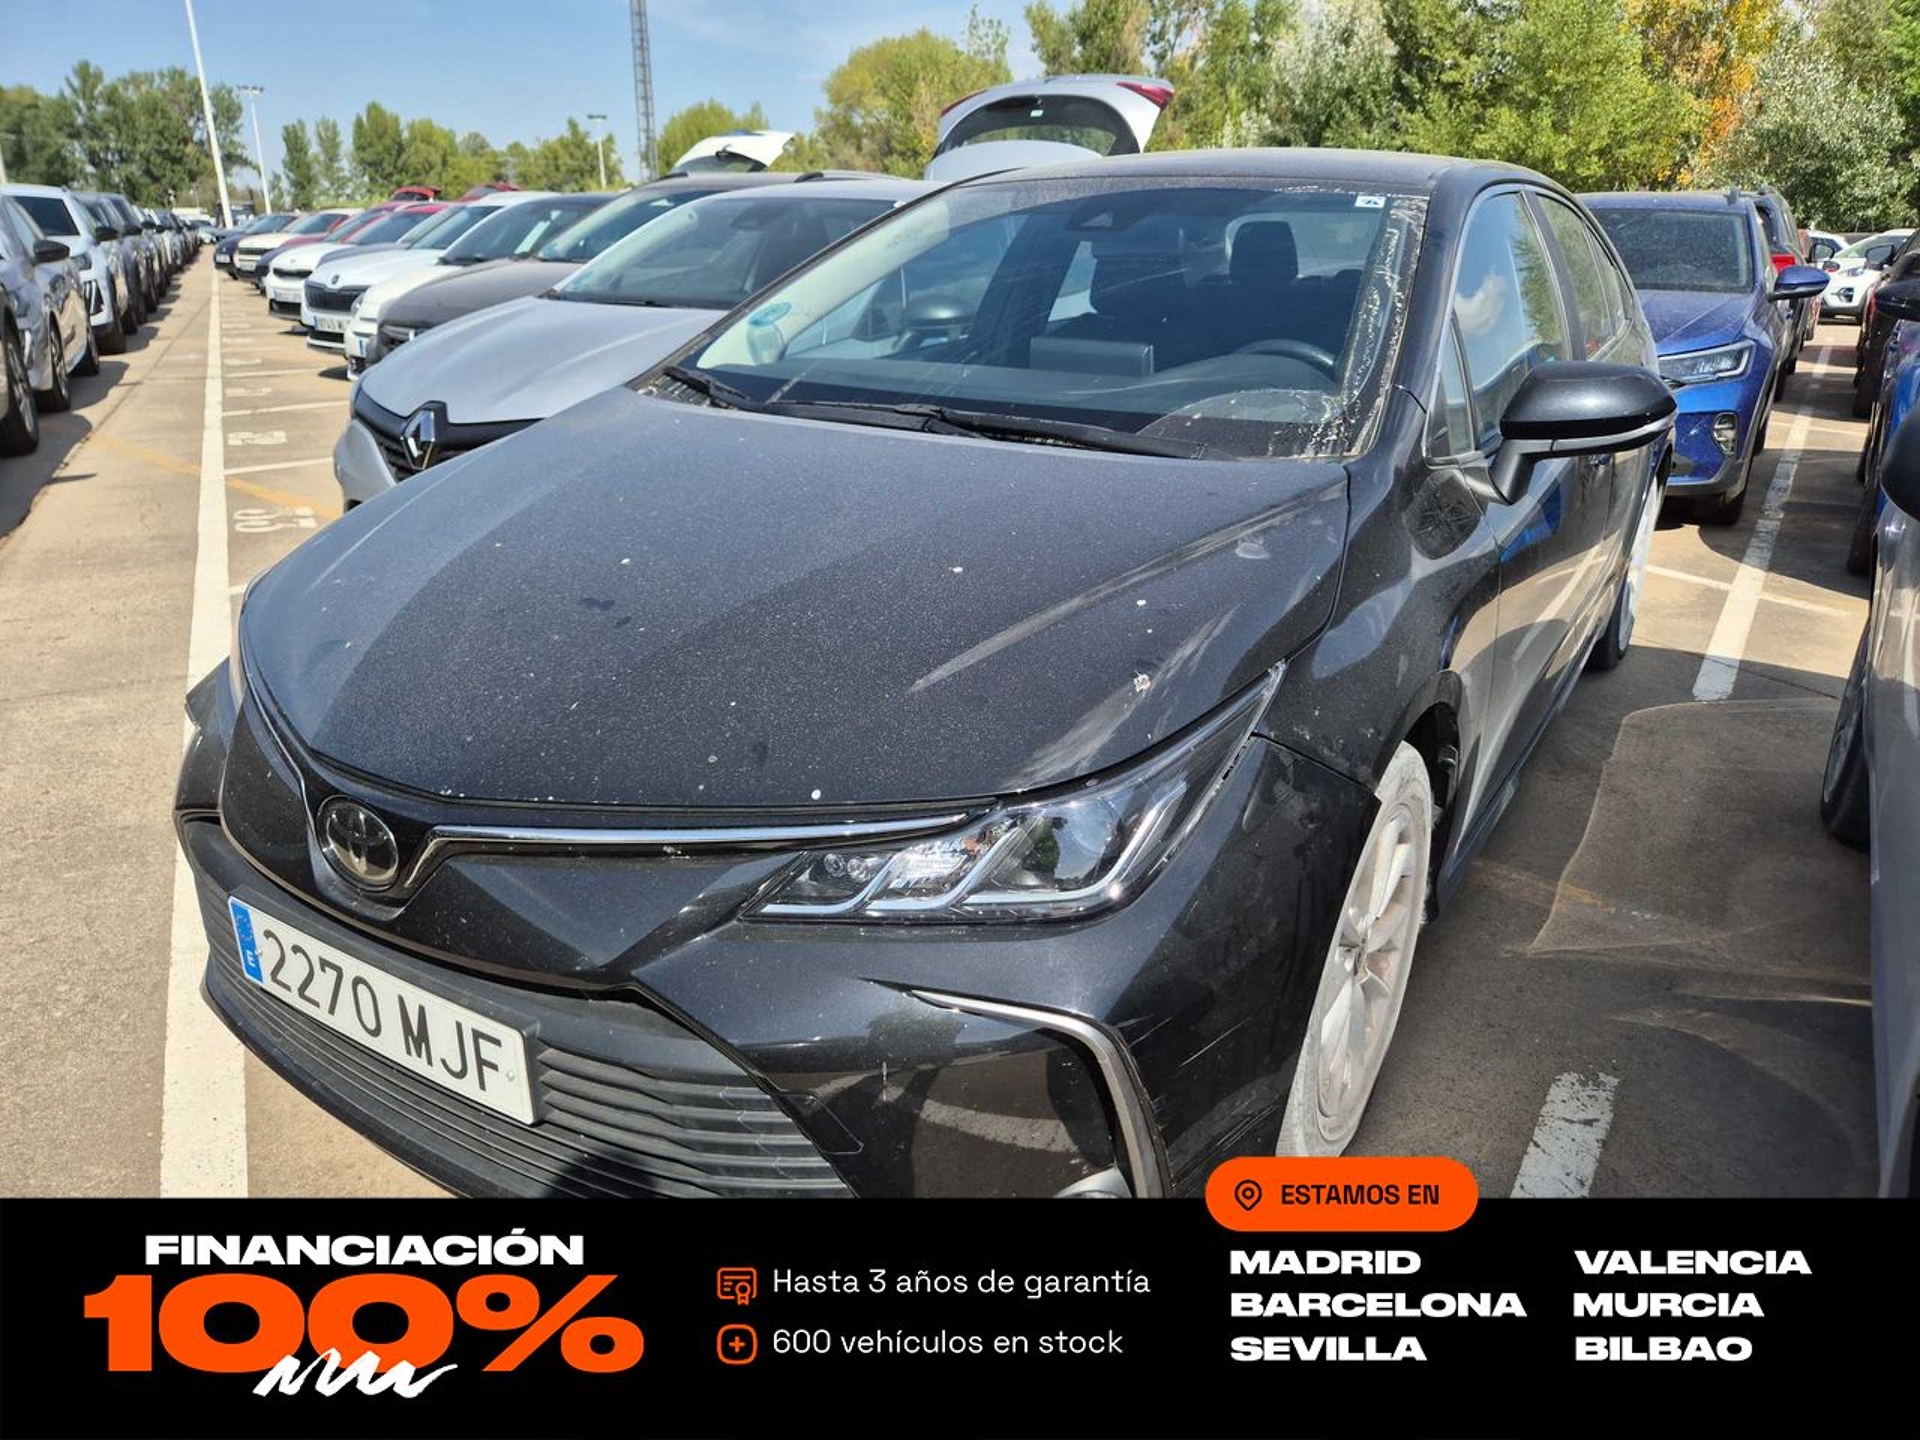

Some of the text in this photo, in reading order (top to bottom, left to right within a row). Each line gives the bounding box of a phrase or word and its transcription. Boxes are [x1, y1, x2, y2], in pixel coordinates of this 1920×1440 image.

[245, 948, 256, 967] E
[263, 929, 502, 1092] 2270 MJF
